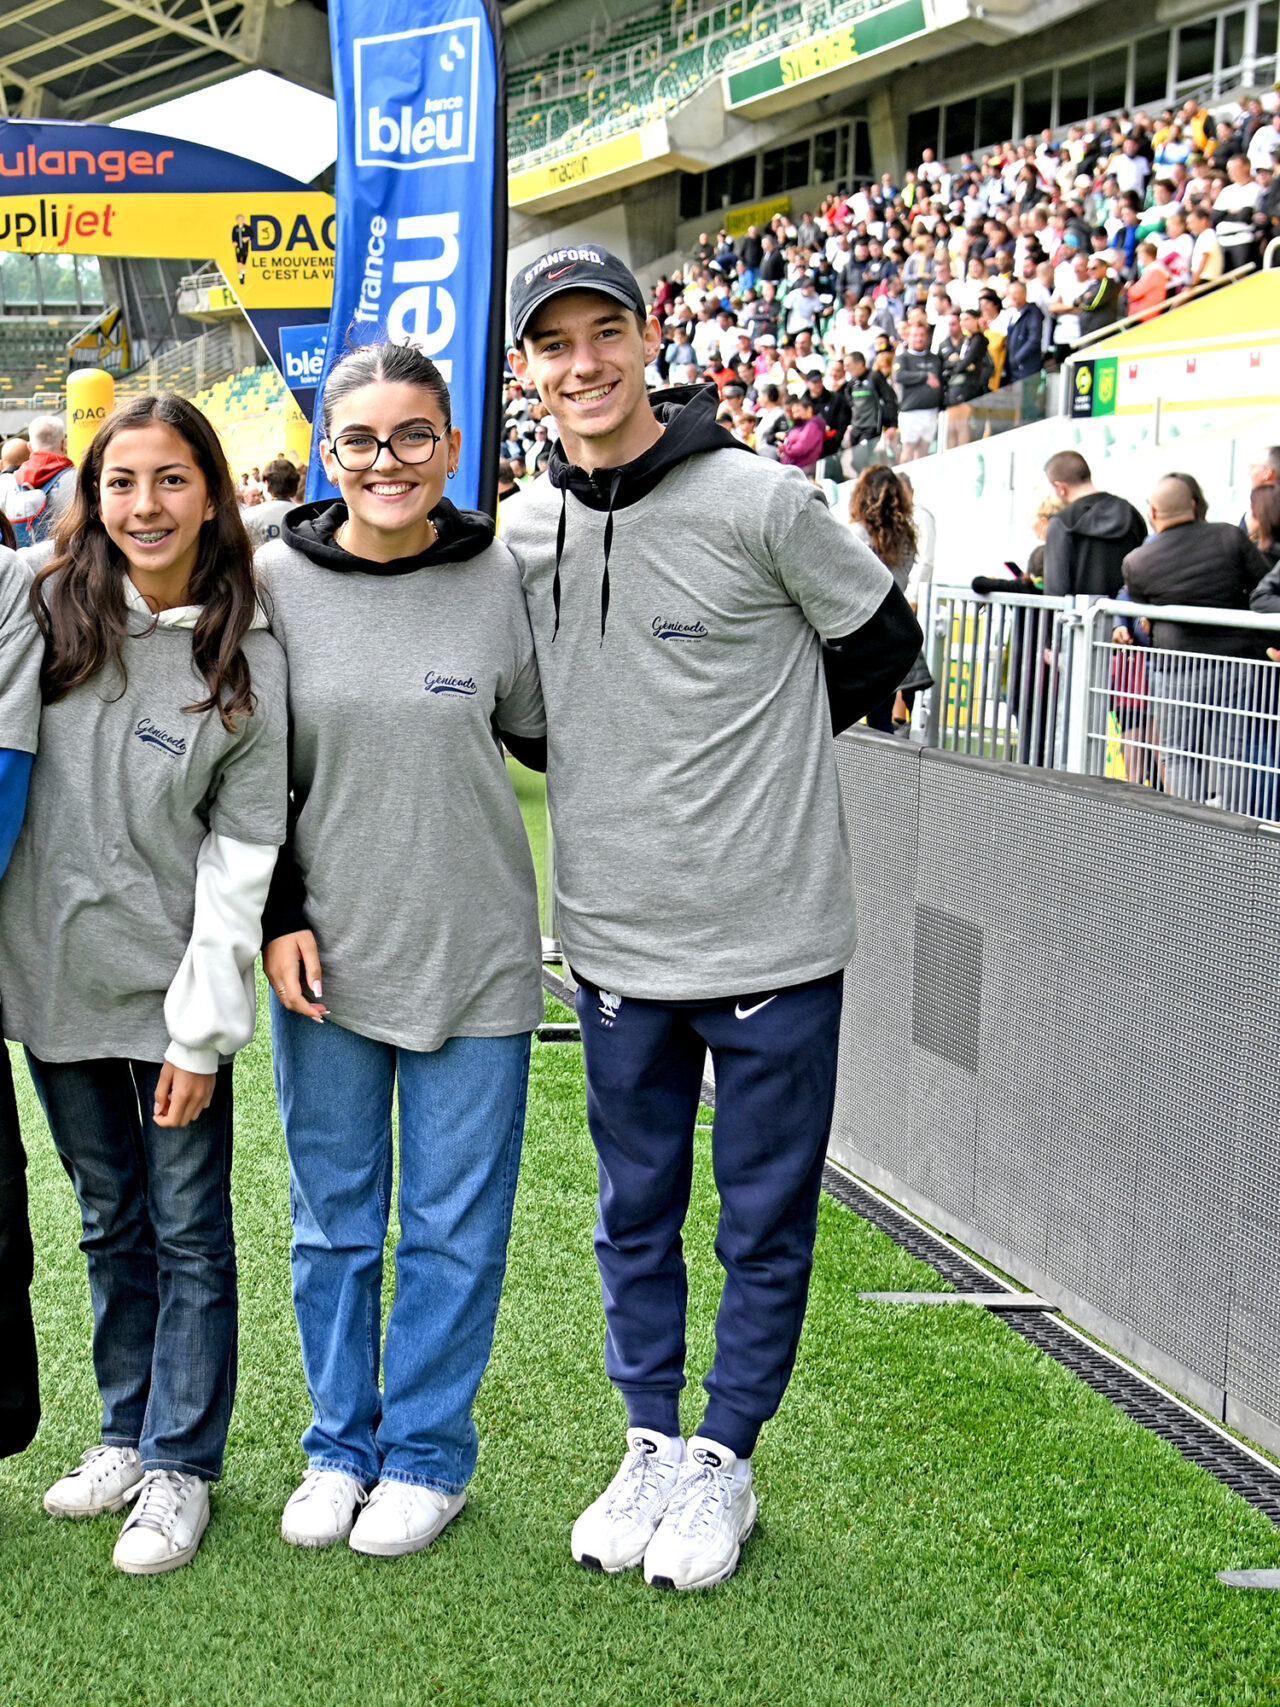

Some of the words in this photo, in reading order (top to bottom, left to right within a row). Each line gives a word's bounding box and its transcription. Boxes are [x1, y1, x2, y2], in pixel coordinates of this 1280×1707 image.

[424, 95, 464, 115] france
[368, 106, 464, 155] bleu
[252, 256, 268, 268] LE
[354, 214, 388, 324] france
[262, 269, 300, 280] C'EST
[303, 269, 319, 280] LA
[322, 269, 334, 280] VI
[285, 350, 324, 377] ble
[76, 406, 106, 421] DAG
